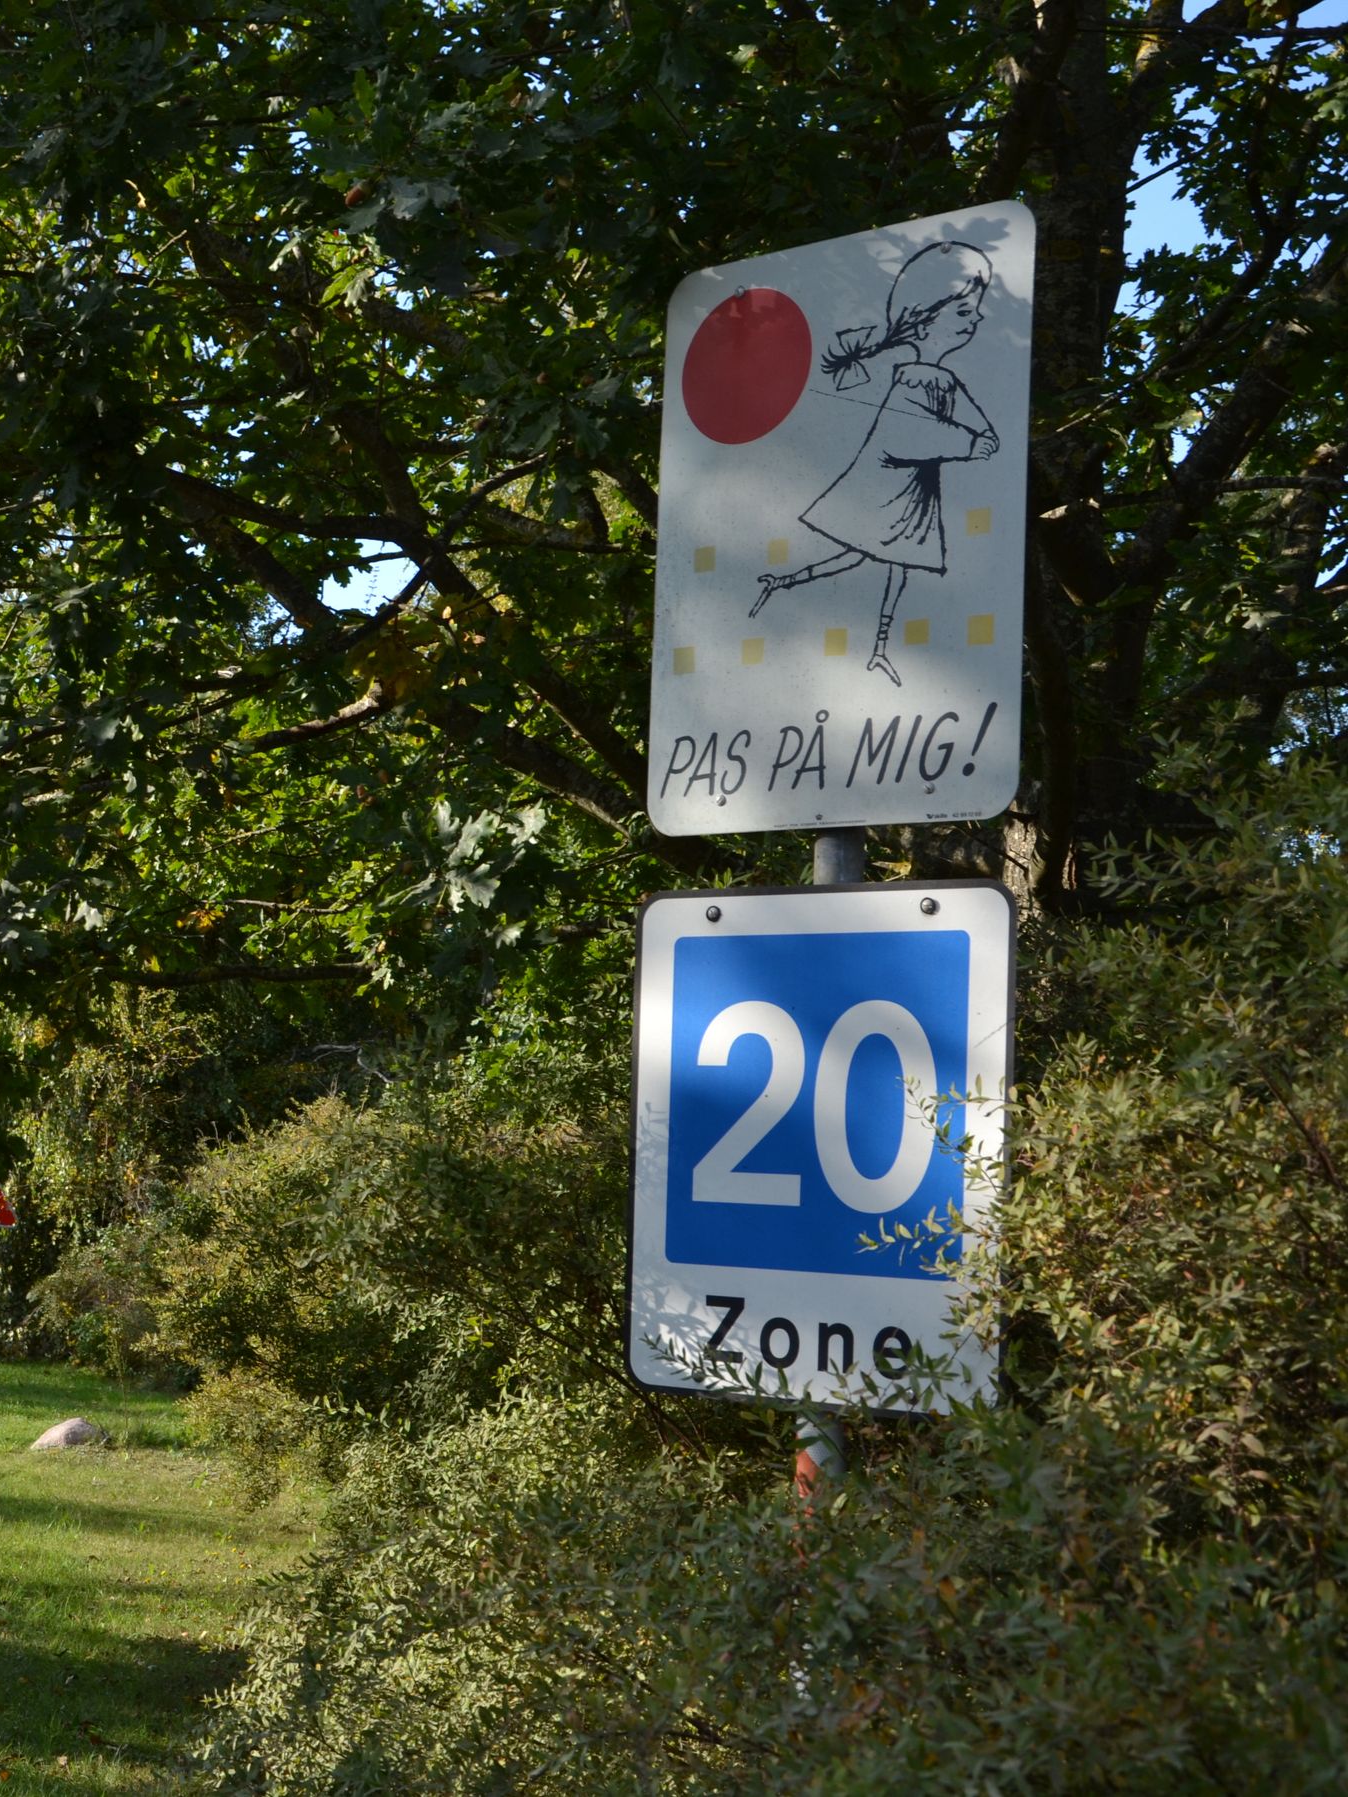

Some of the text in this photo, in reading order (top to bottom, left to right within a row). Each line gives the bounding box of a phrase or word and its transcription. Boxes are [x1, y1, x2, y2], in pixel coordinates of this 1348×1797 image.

[660, 702, 998, 799] PAS PÅ MIG!
[692, 999, 938, 1214] 20
[705, 1294, 912, 1380] Zone
